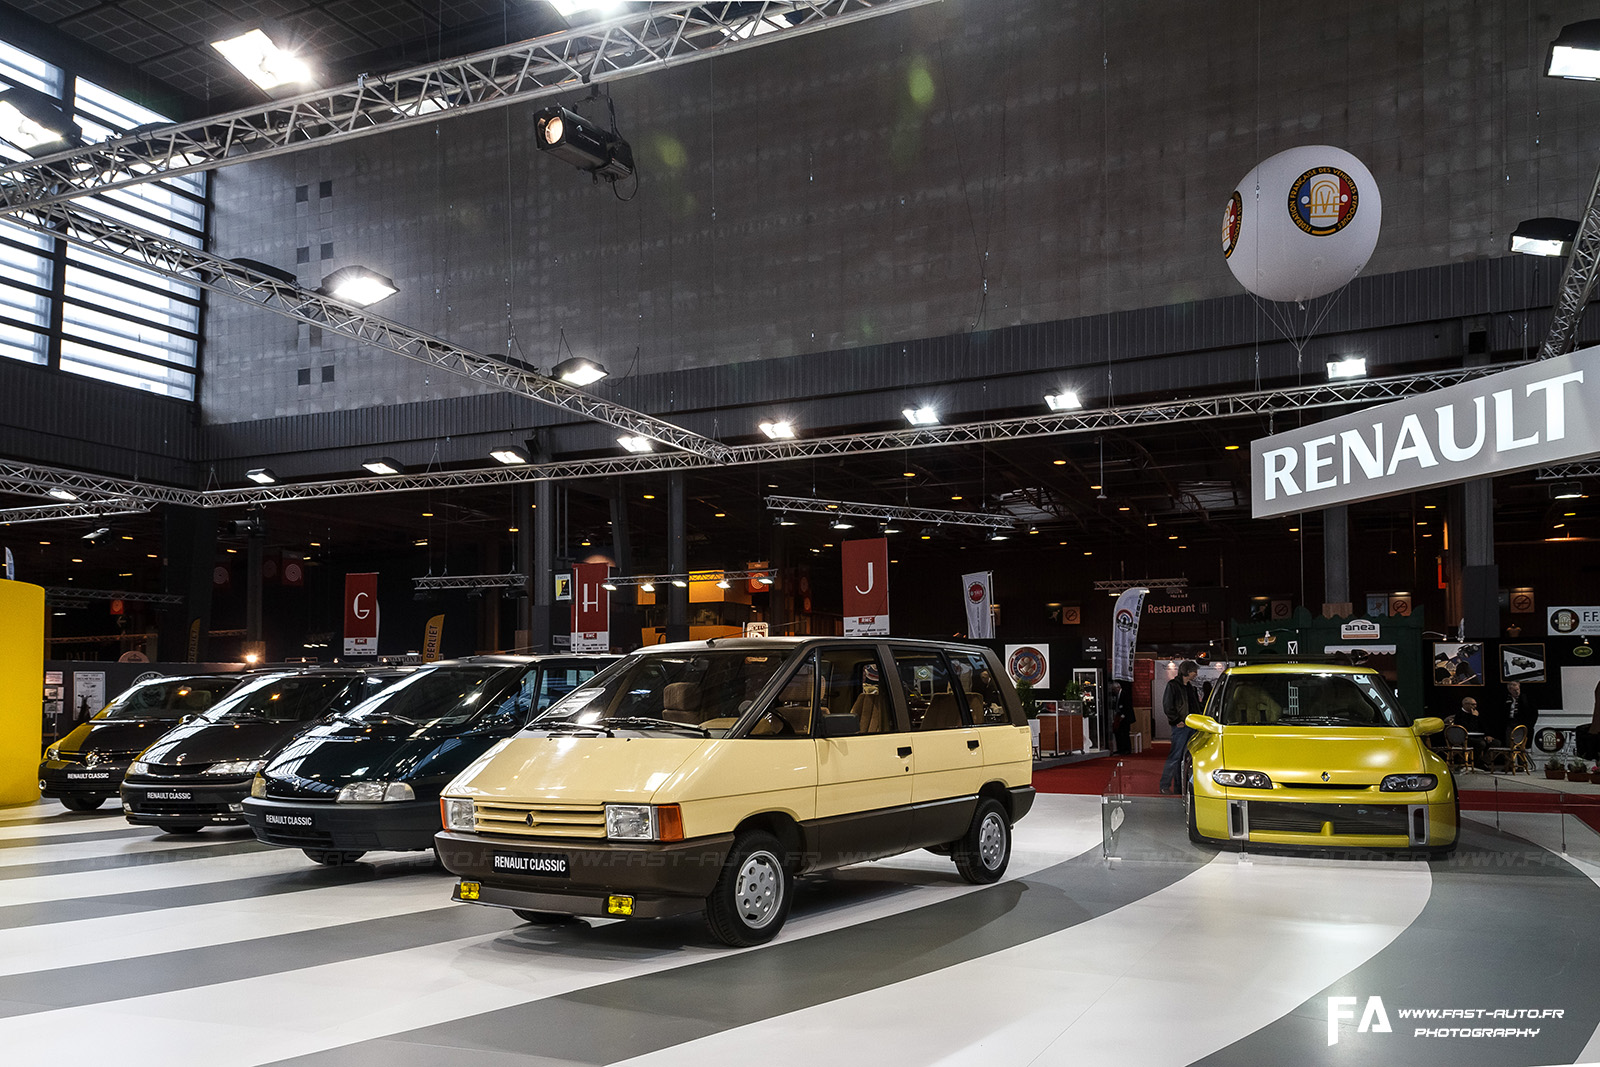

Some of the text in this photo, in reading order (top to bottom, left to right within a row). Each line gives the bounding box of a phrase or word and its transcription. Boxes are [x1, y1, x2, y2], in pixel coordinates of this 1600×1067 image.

[1290, 170, 1317, 198] FRANÇAISE
[1262, 370, 1584, 502] RENAULT
[855, 562, 873, 594] J
[353, 592, 370, 620] G
[582, 583, 599, 612] H
[1148, 604, 1196, 614] Restaurant
[426, 625, 438, 658] BERLIET
[266, 814, 312, 826] RENAULT CLASSIC
[494, 856, 566, 872] RENAULT CLASSIC
